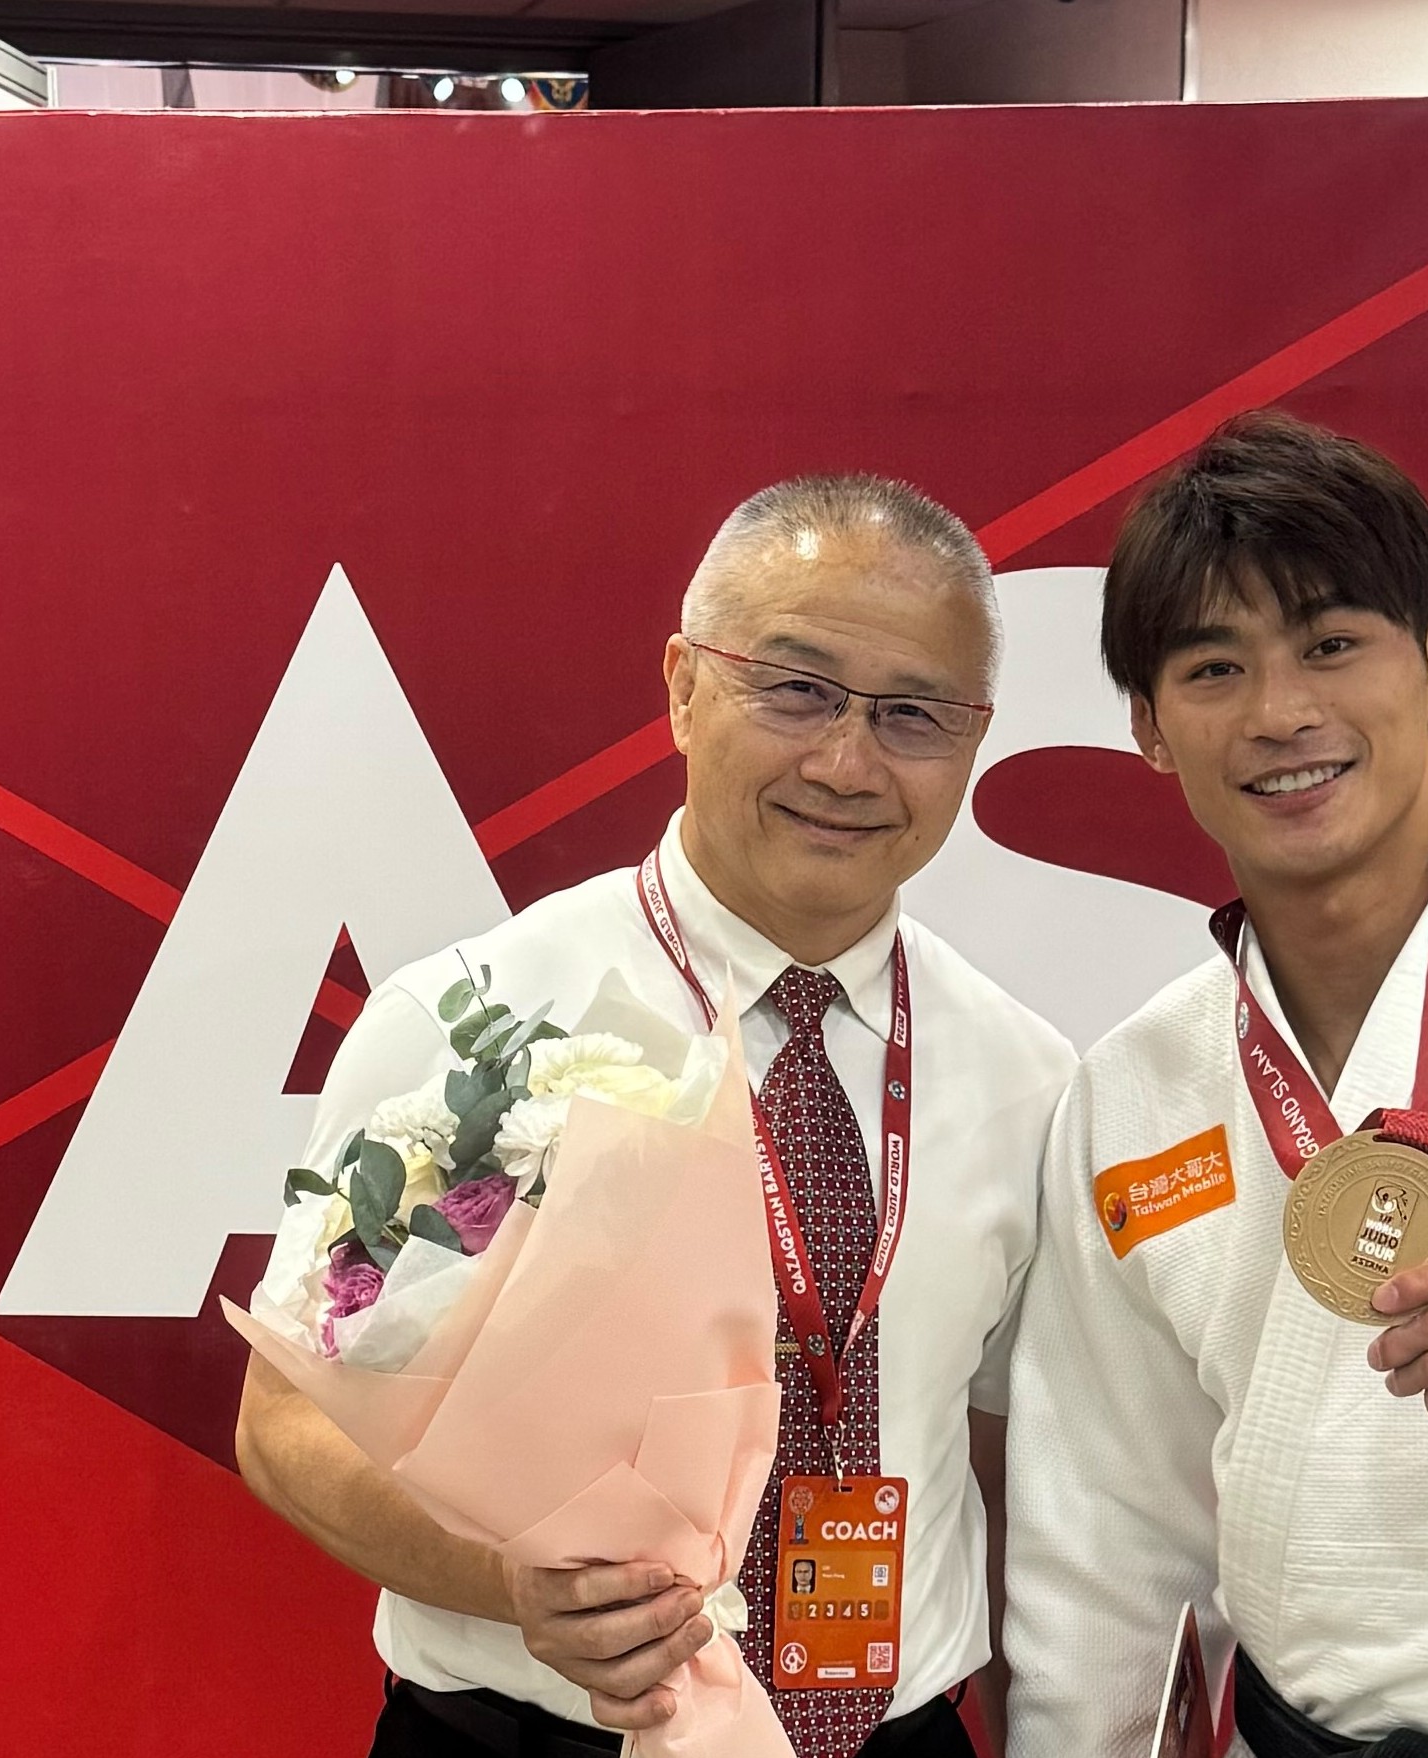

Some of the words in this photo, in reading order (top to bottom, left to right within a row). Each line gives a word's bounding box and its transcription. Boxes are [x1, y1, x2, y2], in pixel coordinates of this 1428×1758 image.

[648, 883, 664, 914] JUDO
[1250, 1044, 1290, 1099] SLAM
[1281, 1096, 1320, 1160] GRAND
[890, 1140, 900, 1187] WORLD
[1128, 1151, 1225, 1203] 台灣大哥大
[887, 1188, 898, 1227] JUDO
[1131, 1193, 1182, 1217] Taiwan
[1181, 1172, 1227, 1199] Mobile
[769, 1196, 807, 1295] QAZAQSTAN
[1360, 1227, 1399, 1249] JUDO
[1365, 1218, 1402, 1239] WORLD
[876, 1232, 892, 1271] TOUR
[1357, 1238, 1396, 1262] TOUR
[821, 1521, 898, 1541] COACH
[808, 1604, 818, 1618] 2
[826, 1604, 834, 1617] 3
[842, 1604, 852, 1617] 4
[860, 1604, 869, 1617] 5
